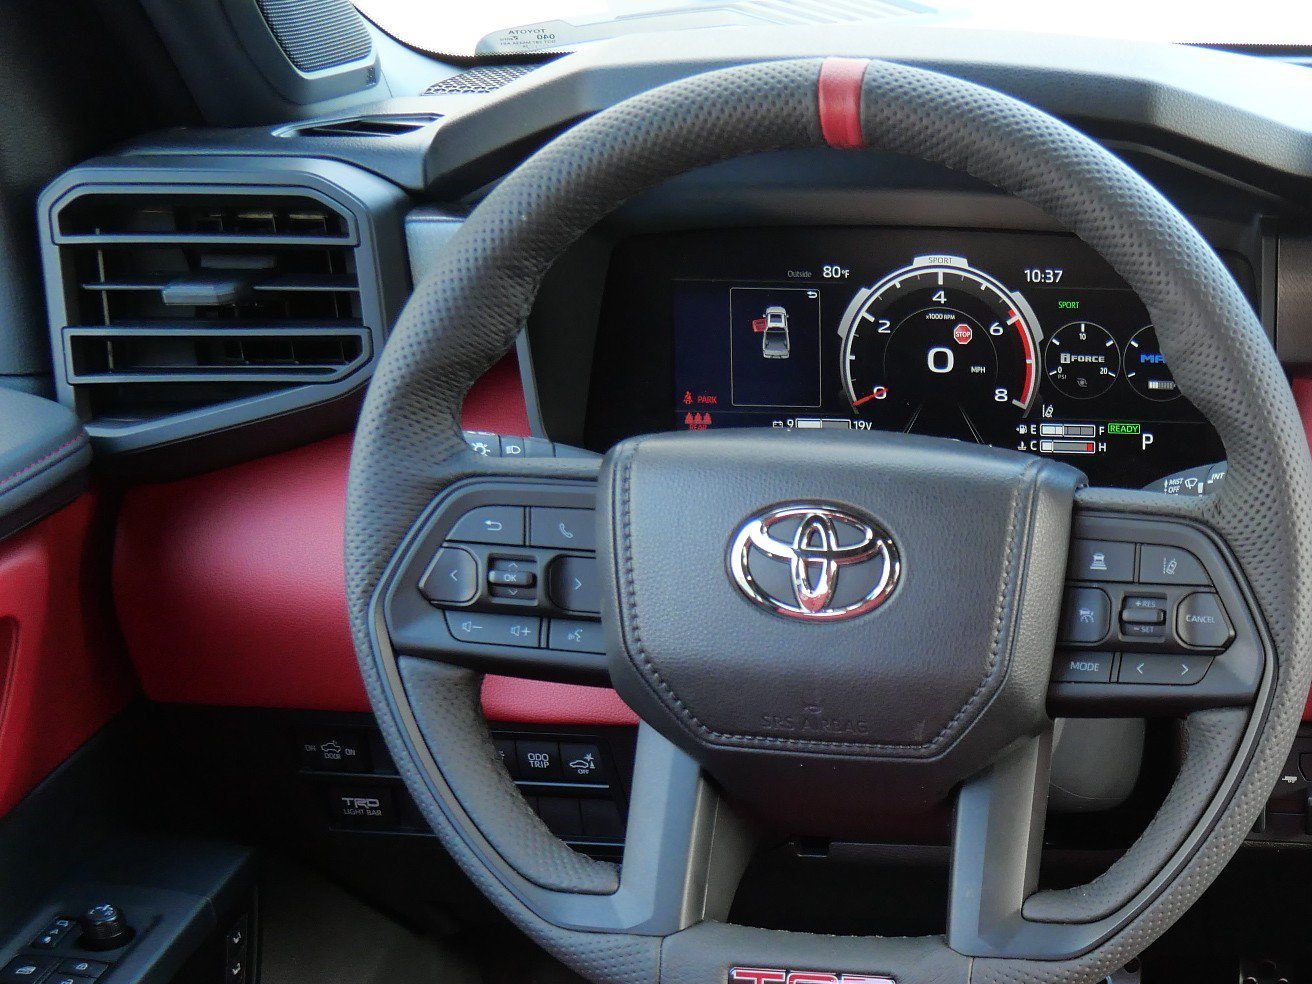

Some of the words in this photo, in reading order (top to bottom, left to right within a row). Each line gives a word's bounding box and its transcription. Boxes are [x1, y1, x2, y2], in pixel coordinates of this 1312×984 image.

[787, 270, 812, 278] Outside
[1024, 269, 1063, 283] 10:37
[932, 290, 947, 304] 4
[1058, 301, 1079, 309] SPORT
[878, 320, 891, 333] 2
[990, 322, 1003, 336] 6
[927, 347, 954, 373] 0
[1140, 354, 1166, 363] MA
[970, 366, 986, 374] MPH
[1057, 366, 1063, 374] 0
[1100, 367, 1108, 375] 20
[995, 389, 1008, 402] 8
[853, 420, 872, 430] 19V
[1110, 425, 1138, 433] READY
[1031, 425, 1037, 435] E
[1099, 427, 1105, 435] F
[1030, 441, 1037, 450] C
[1142, 434, 1154, 450] P
[1099, 442, 1107, 452] H
[1212, 472, 1225, 480] INT
[1168, 478, 1184, 486] MIST
[504, 574, 517, 582] OK
[1186, 615, 1216, 624] CANCEL
[1070, 661, 1100, 672] MODE
[527, 752, 549, 762] ODO
[529, 760, 550, 769] TRIP
[341, 797, 380, 809] TRD
